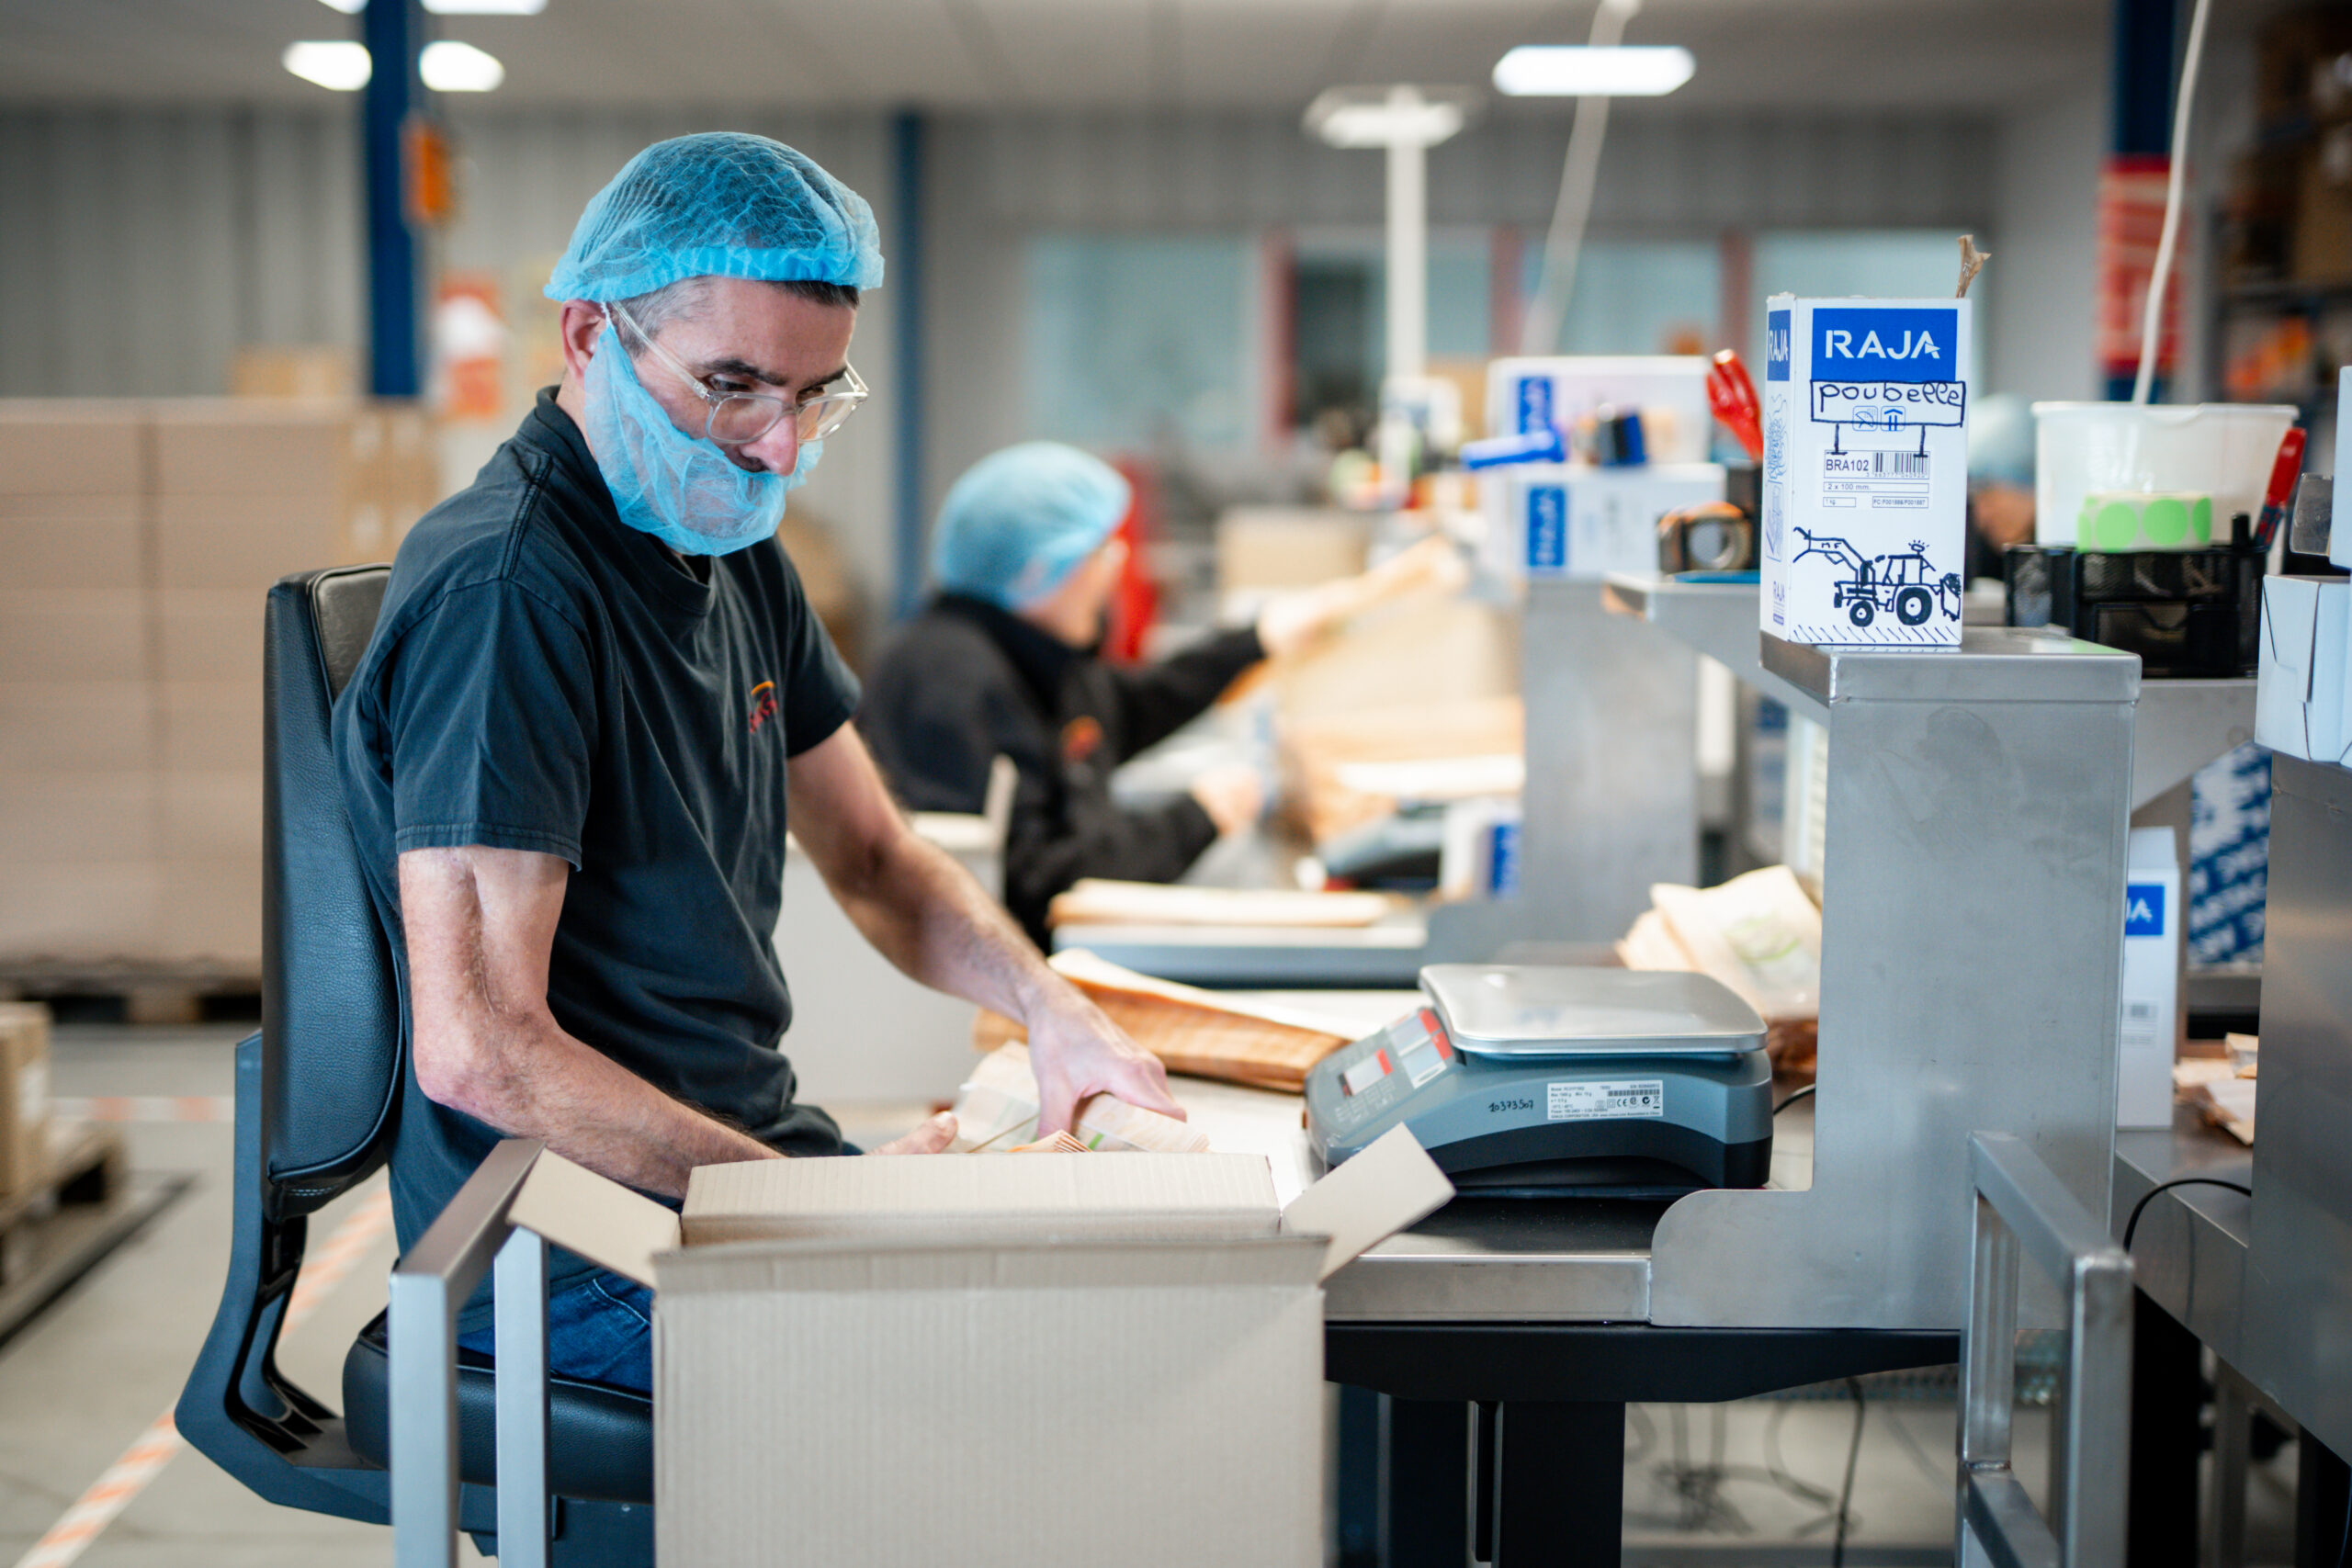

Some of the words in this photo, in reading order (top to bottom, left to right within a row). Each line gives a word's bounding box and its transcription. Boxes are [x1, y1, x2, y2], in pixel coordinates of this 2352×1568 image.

[1768, 329, 1789, 362] RAJA
[1825, 330, 1940, 359] RAJA
[1819, 381, 1962, 412] poubelle
[1826, 458, 1869, 471] BRA102
